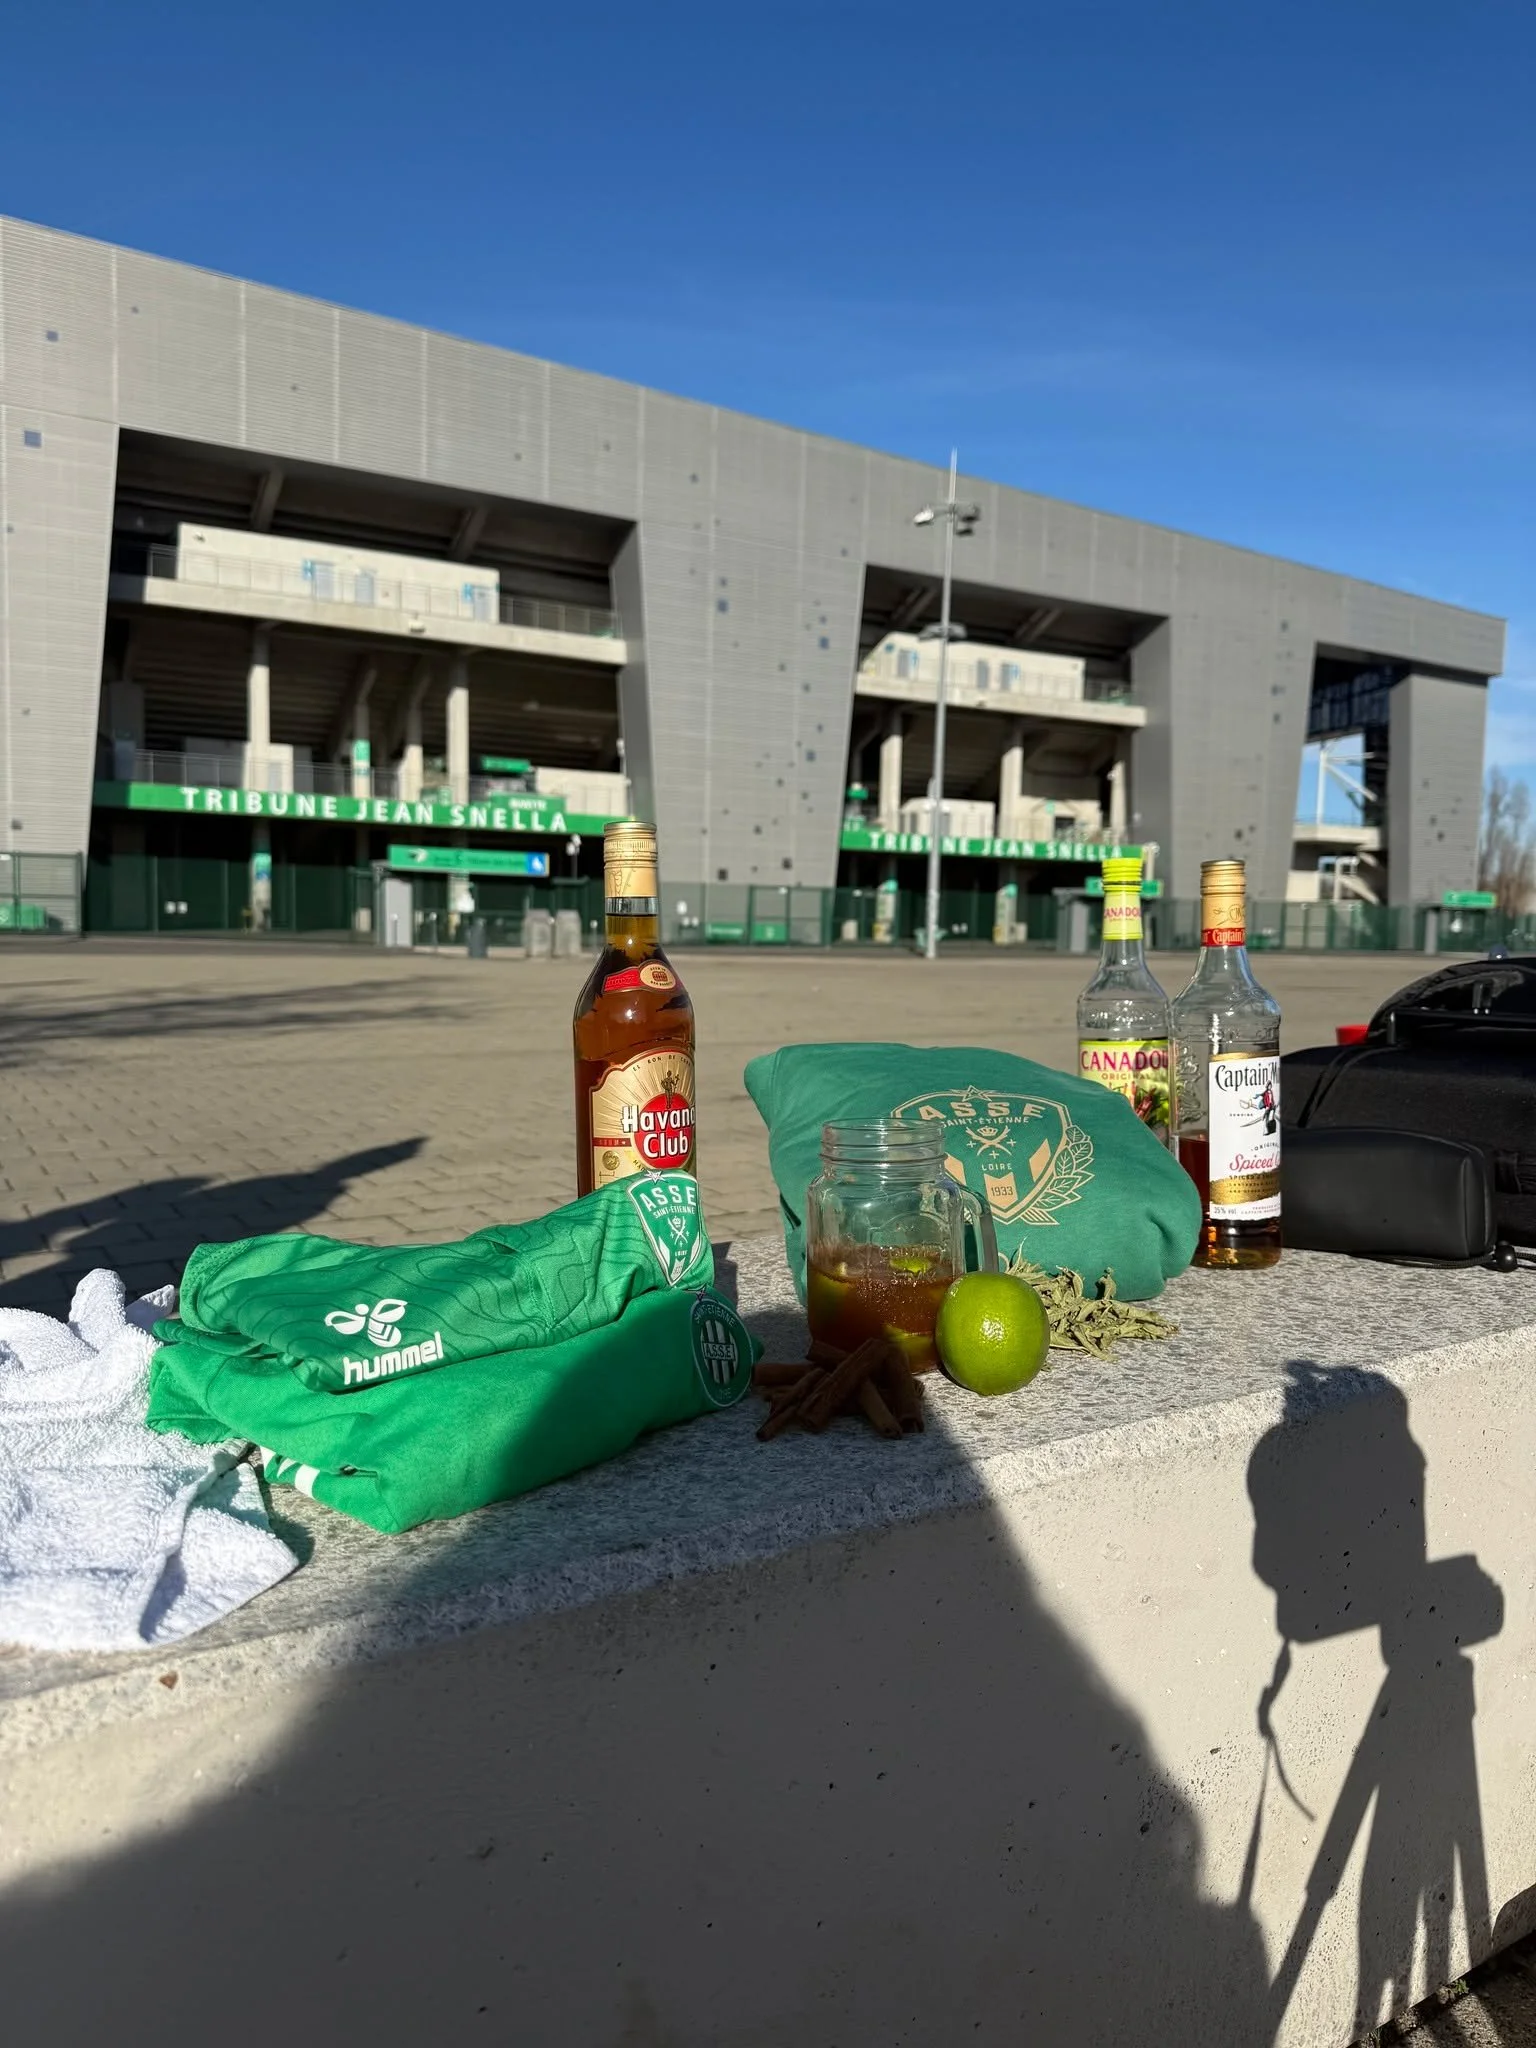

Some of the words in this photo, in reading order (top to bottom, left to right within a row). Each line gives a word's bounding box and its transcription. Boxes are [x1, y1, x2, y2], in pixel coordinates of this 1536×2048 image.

[181, 786, 338, 819] TRIBUNE
[355, 798, 434, 824] JEAN
[450, 805, 568, 832] SNELLA
[980, 838, 1036, 858] JEAN
[1046, 839, 1122, 861] SNELLA
[1212, 929, 1243, 945] Captain
[1215, 1062, 1268, 1092] Captain
[917, 1101, 1046, 1121] ASSE
[643, 1130, 690, 1159] Club
[981, 1163, 1013, 1171] LOIRE
[1229, 1153, 1275, 1172] Spiced
[640, 1185, 697, 1212] ASSE
[990, 1186, 1014, 1197] 1933
[343, 1331, 444, 1385] hummel
